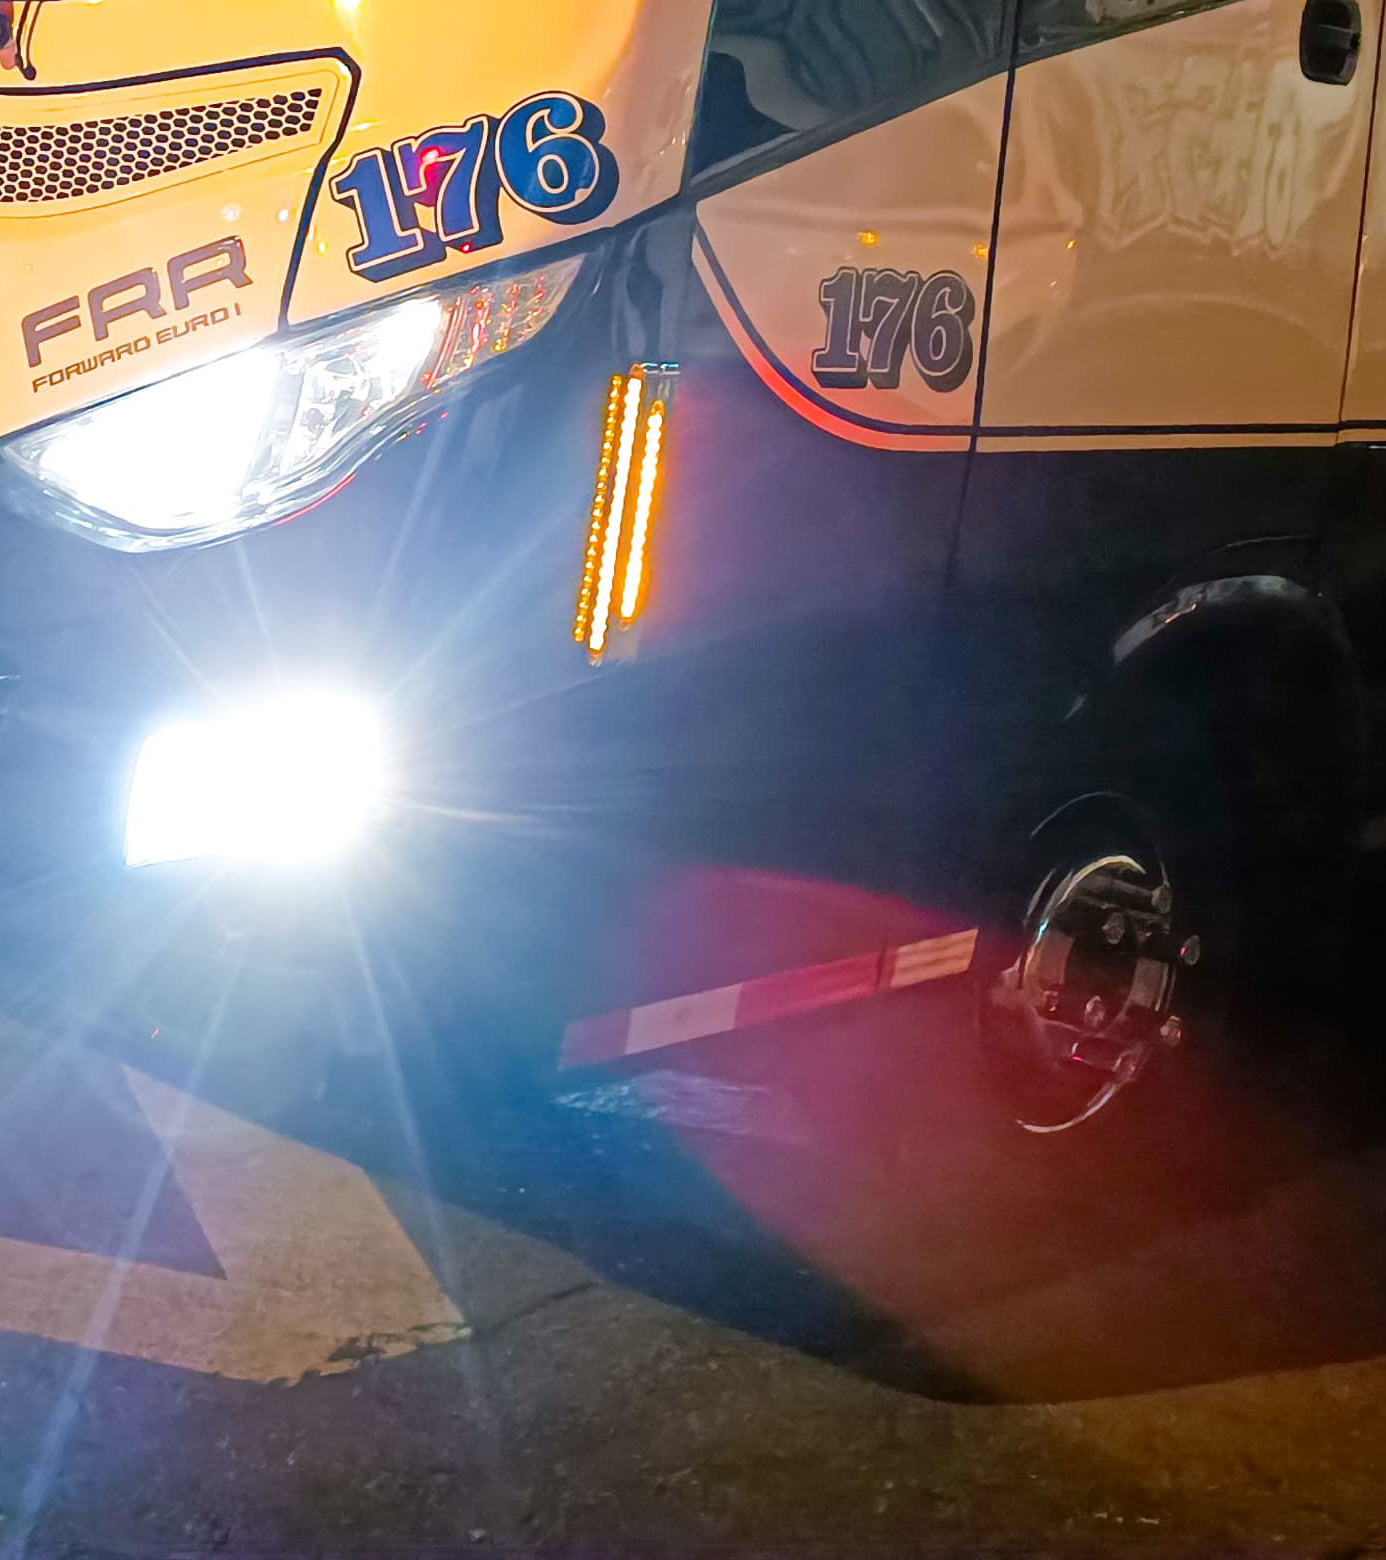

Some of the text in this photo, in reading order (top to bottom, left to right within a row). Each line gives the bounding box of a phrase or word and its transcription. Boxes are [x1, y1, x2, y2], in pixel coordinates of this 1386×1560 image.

[329, 90, 619, 283] 176
[21, 235, 253, 368] FRR
[32, 336, 151, 393] FORWARD
[156, 307, 229, 344] EURO
[811, 266, 975, 393] 176
